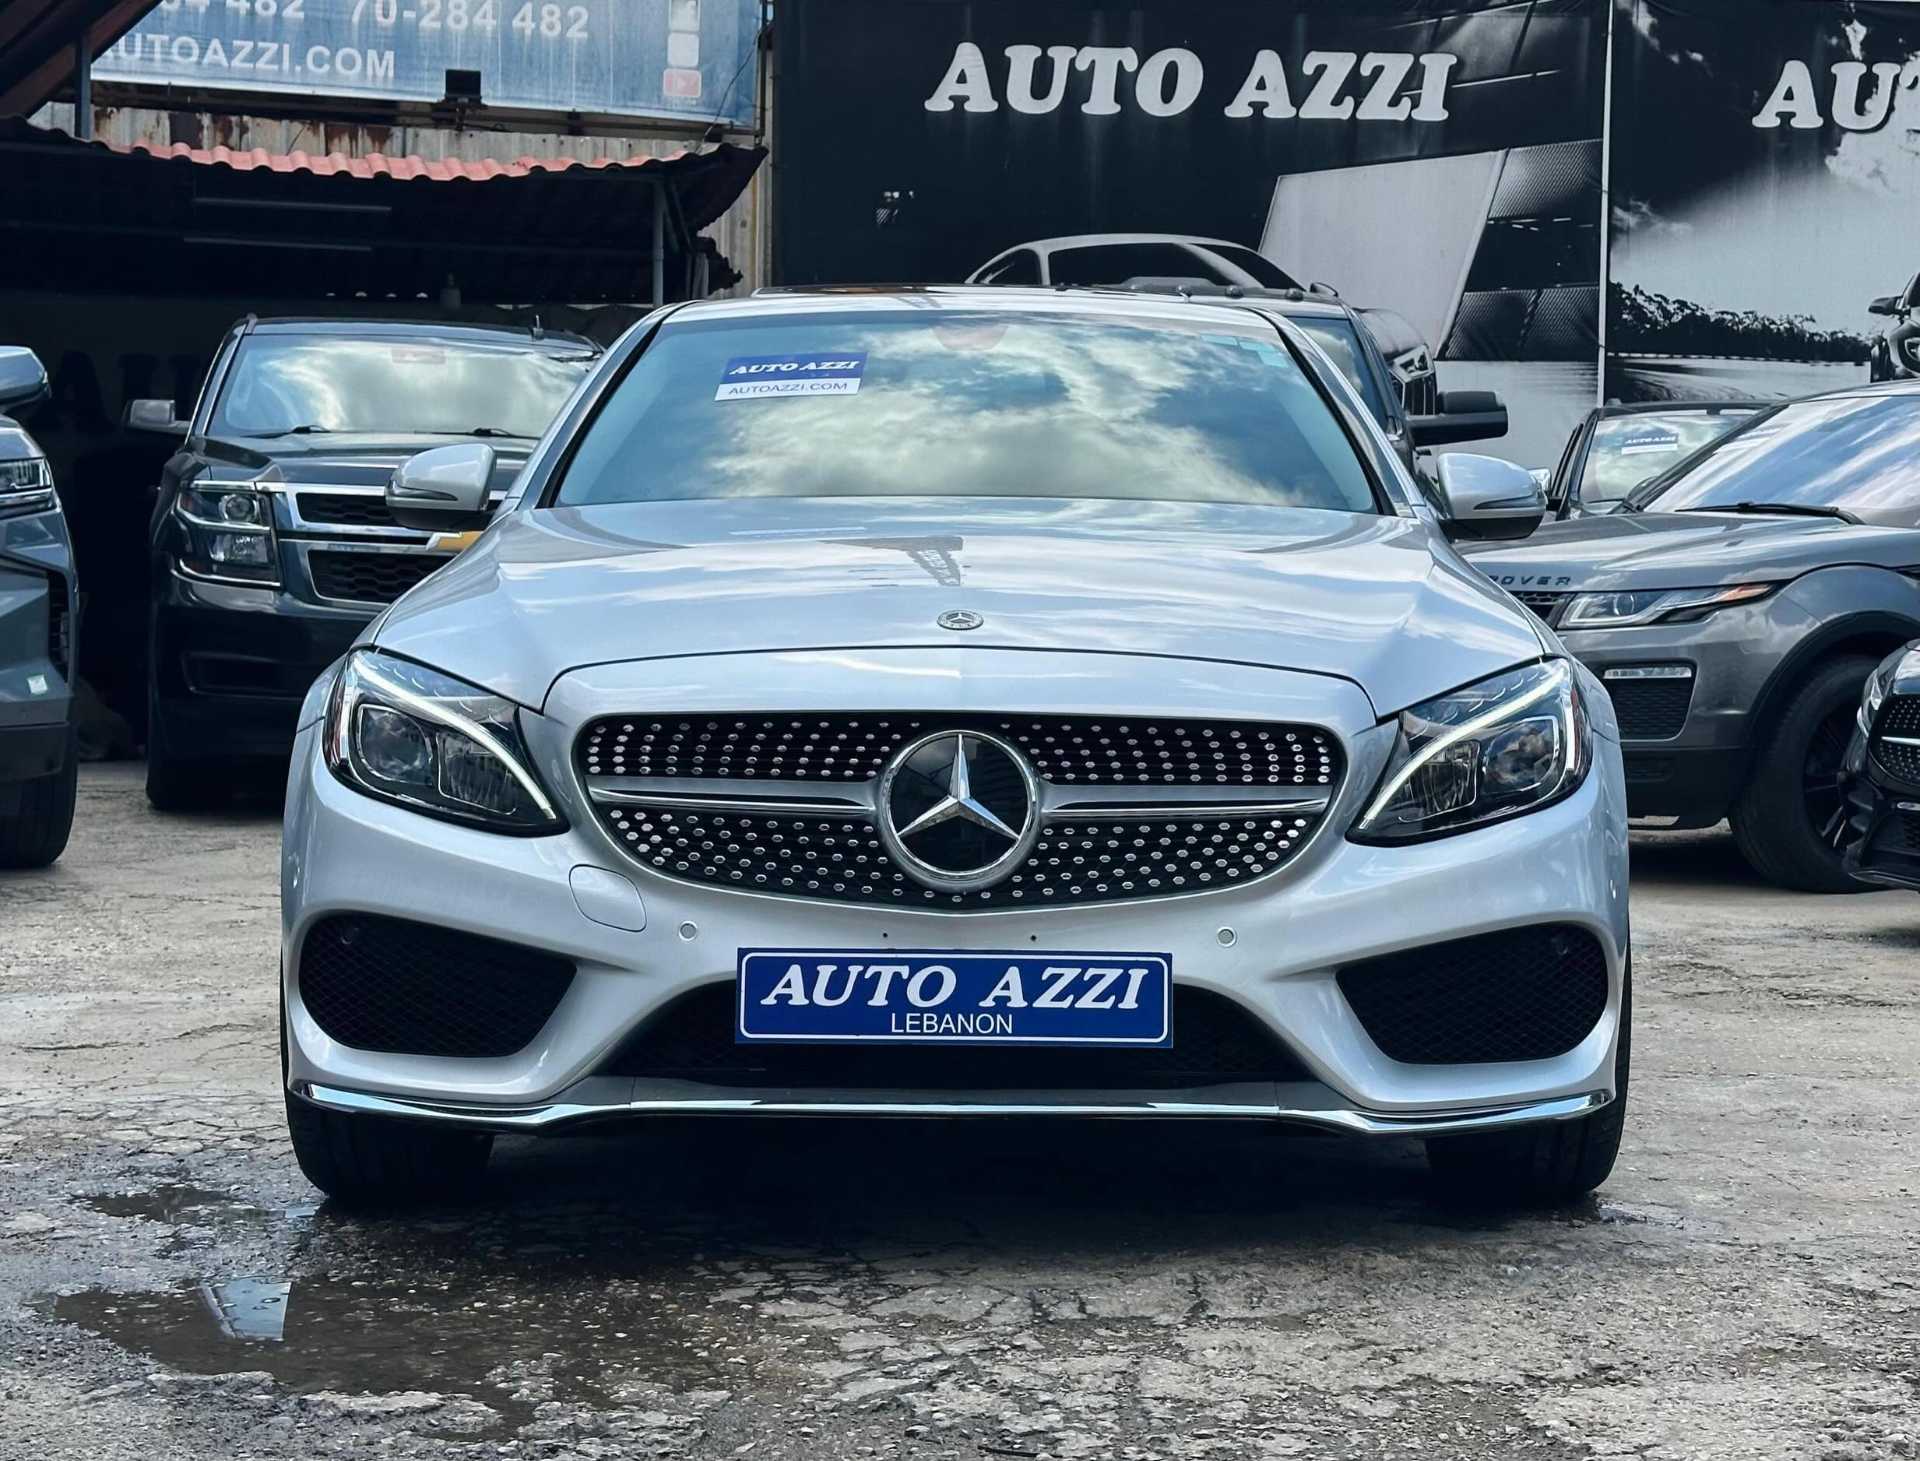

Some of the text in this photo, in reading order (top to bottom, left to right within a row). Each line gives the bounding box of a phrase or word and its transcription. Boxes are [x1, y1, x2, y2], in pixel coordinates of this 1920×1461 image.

[351, 0, 589, 38] 70-284 482
[103, 32, 395, 78] UTOAZZI.COM
[924, 42, 1457, 121] AUTO AZZI
[729, 361, 860, 375] AUTO AZZI
[729, 382, 848, 395] AUTOAZZI.COM
[760, 964, 1149, 1009] AUTO AZZI
[891, 1012, 1013, 1034] LEBANON
